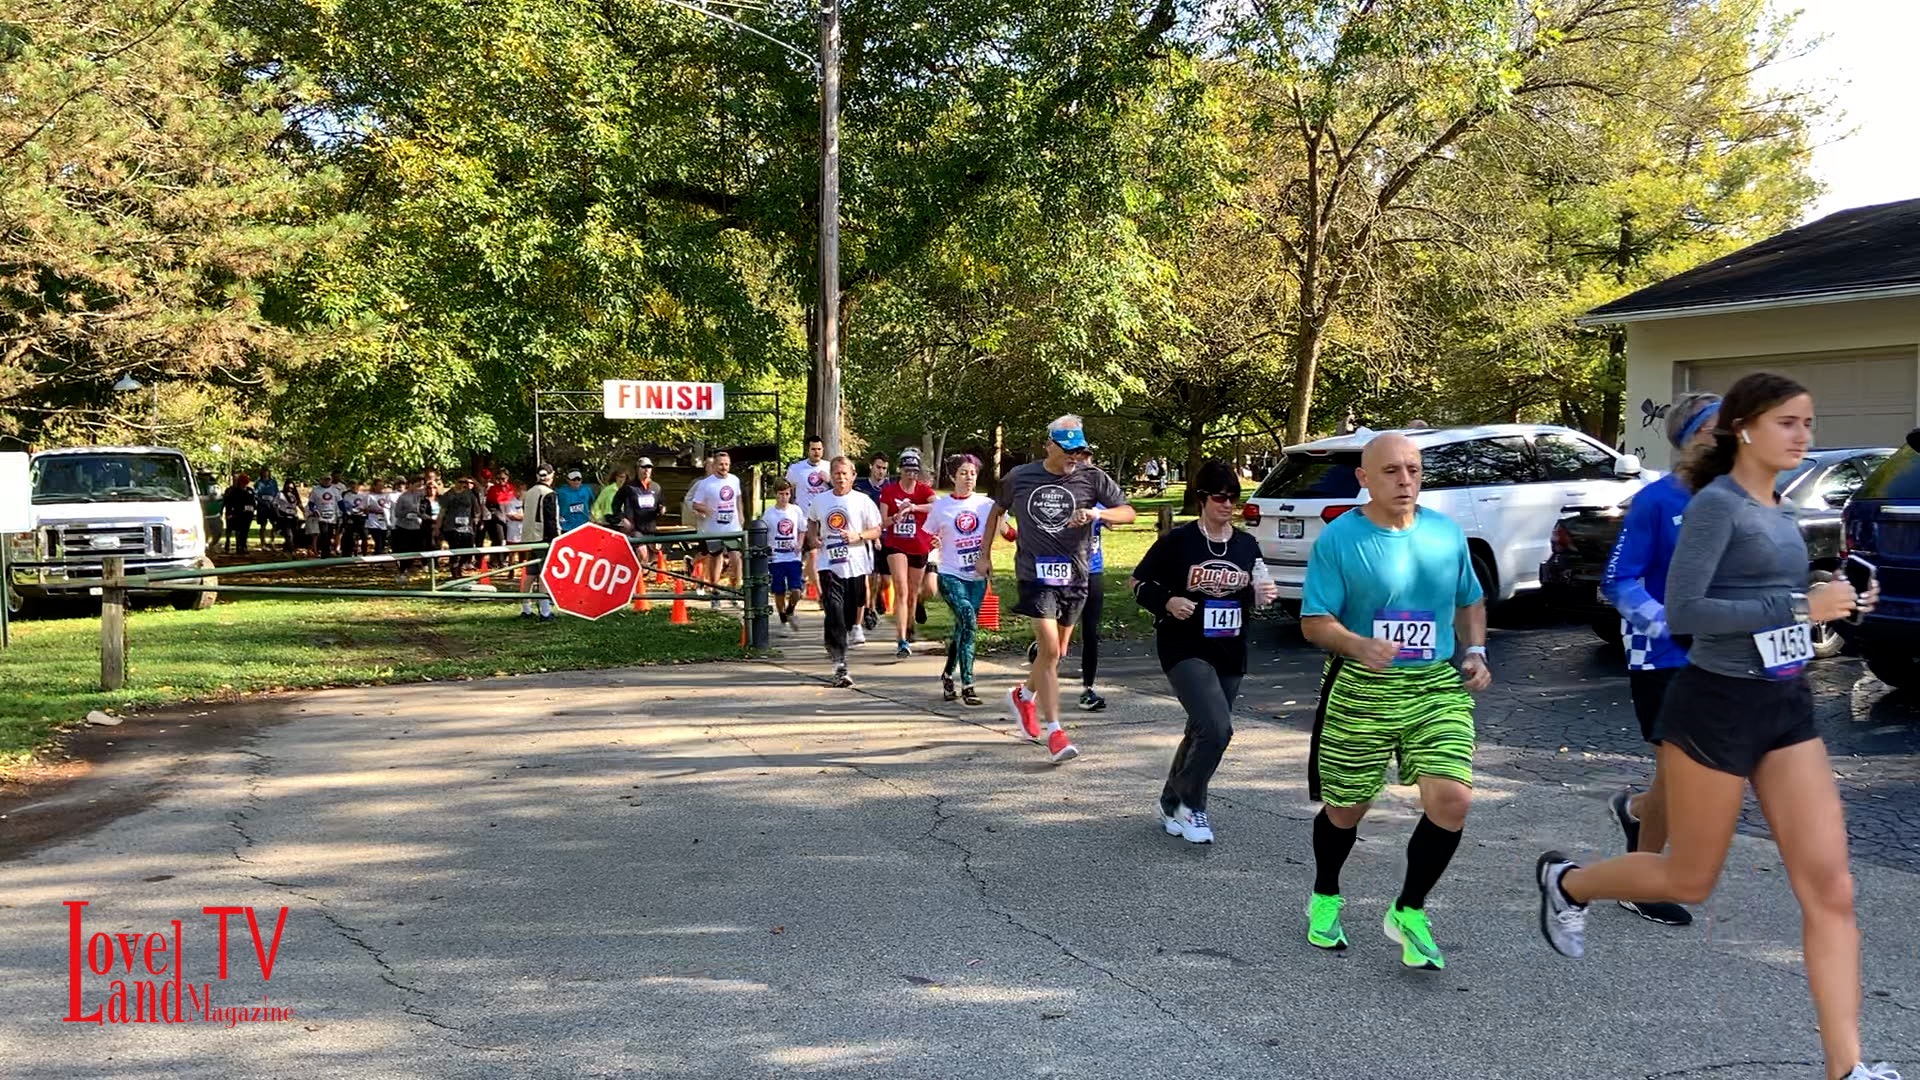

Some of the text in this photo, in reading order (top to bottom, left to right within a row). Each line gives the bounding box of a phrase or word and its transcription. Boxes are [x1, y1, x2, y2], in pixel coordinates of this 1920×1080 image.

[618, 385, 712, 410] FINISH
[829, 546, 849, 559] 1459
[551, 546, 632, 595] STOP
[1041, 564, 1068, 578] 1458
[1382, 622, 1431, 647] 1422
[1769, 626, 1807, 663] 1453
